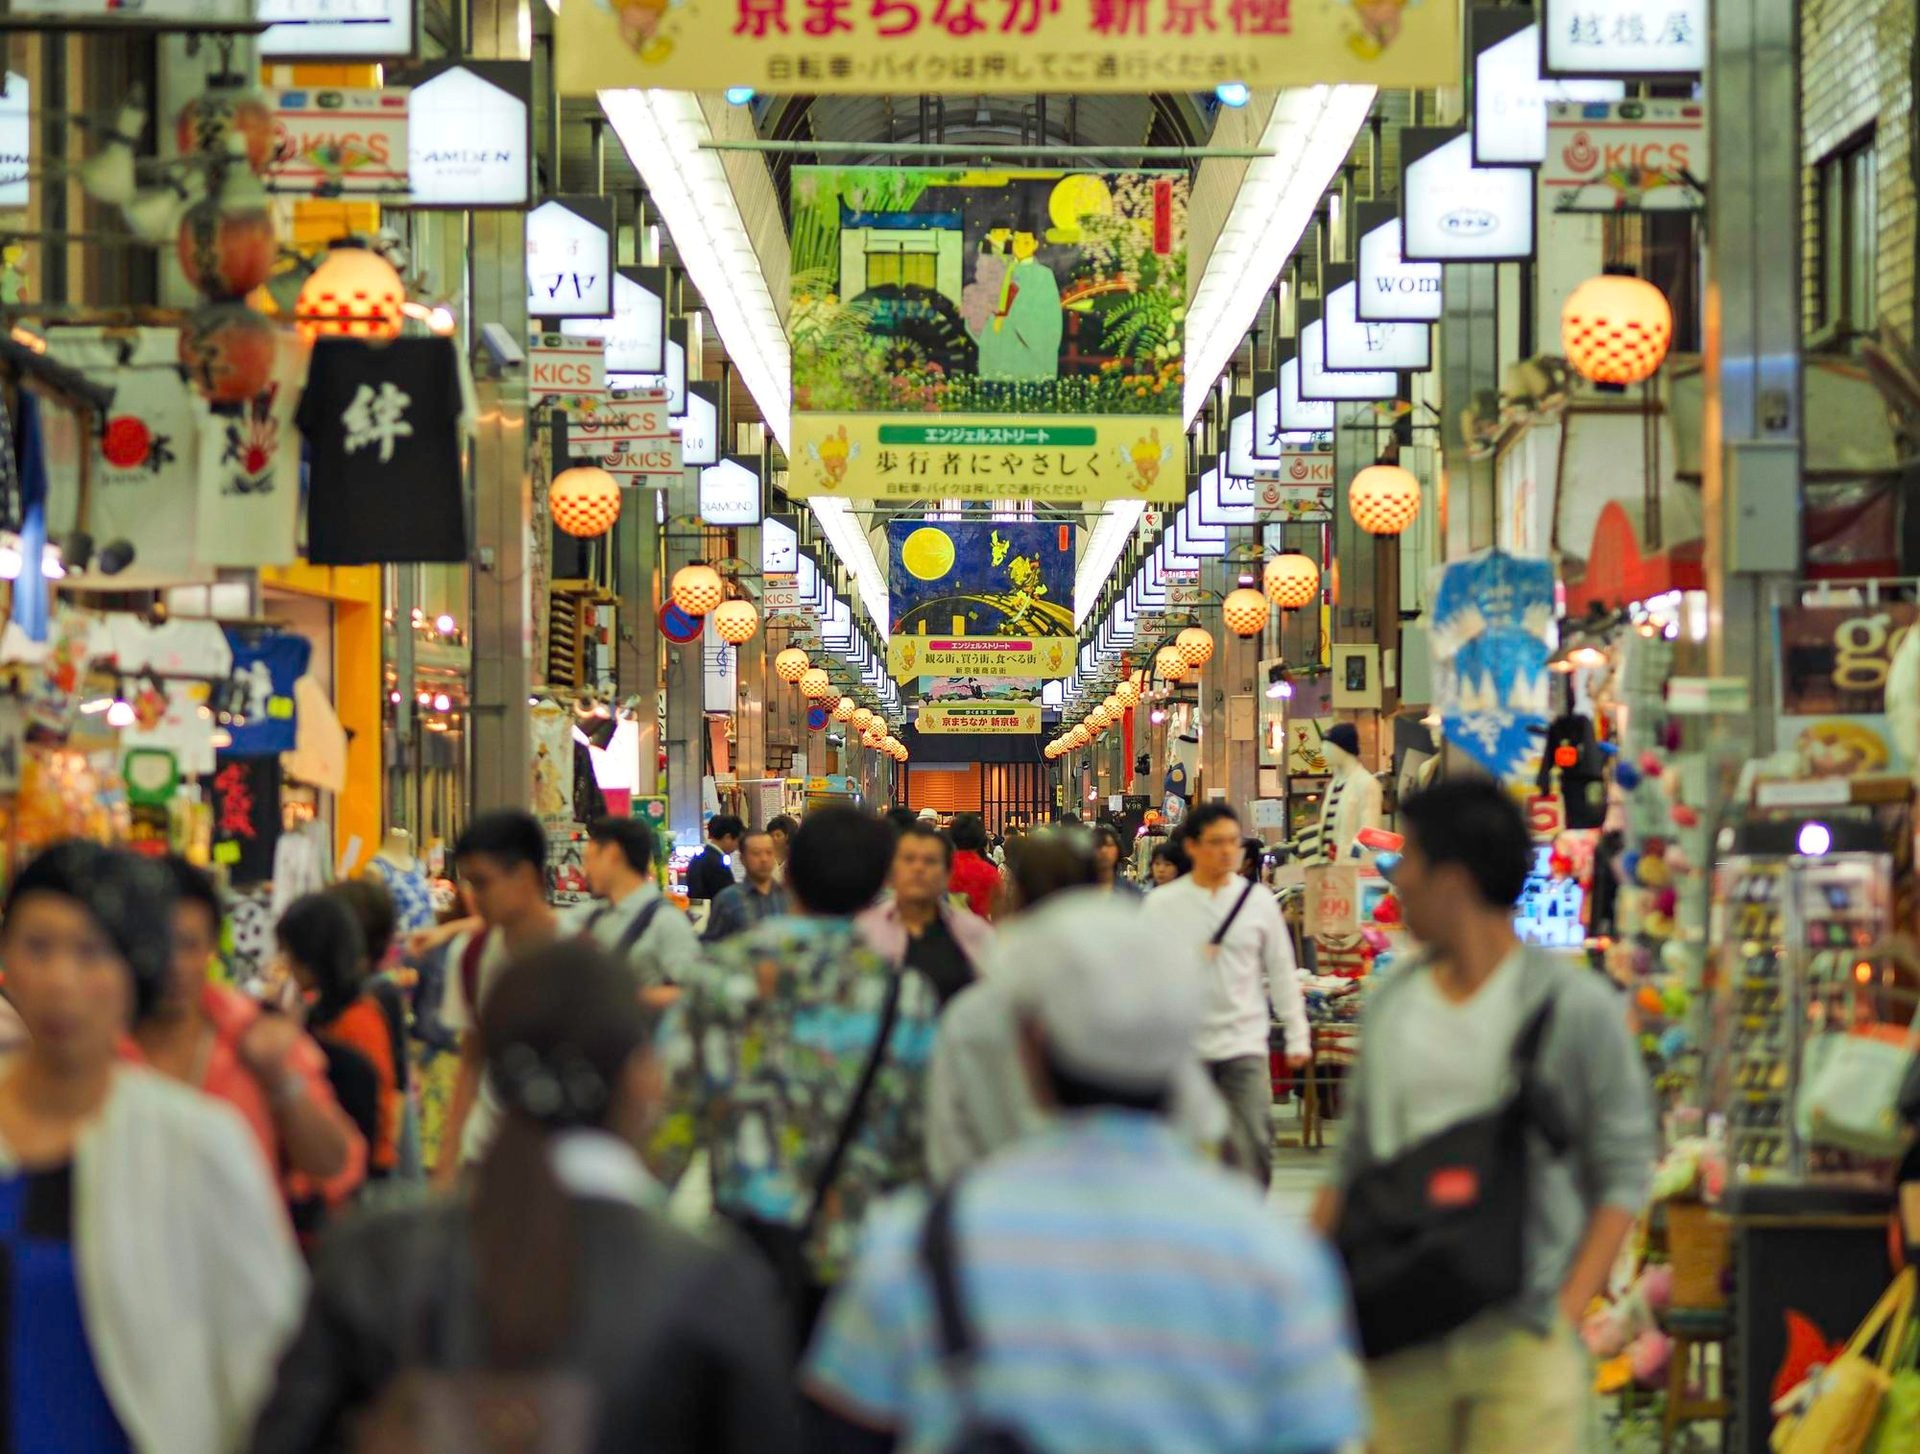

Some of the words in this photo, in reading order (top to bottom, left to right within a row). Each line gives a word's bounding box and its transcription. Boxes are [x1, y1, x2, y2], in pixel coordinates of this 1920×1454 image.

[1604, 143, 1690, 174] KICS
[533, 364, 592, 386] KICS
[341, 381, 414, 463] 絆
[603, 412, 657, 433] KICS
[924, 427, 1050, 444] エンジェルストリート
[625, 451, 673, 468] KICS
[876, 450, 1101, 477] 歩行者にやさしく
[886, 482, 1088, 496] 自転車・バイクは押してご通行ください
[700, 501, 752, 513] DIAMOND
[765, 593, 793, 605] KICS
[951, 642, 1011, 650] エンジェルストリート
[925, 653, 1037, 664] 観る街、買う街、食べる街
[955, 667, 1007, 675] 新京極商店街
[942, 717, 988, 727] 京まちなか
[991, 717, 1020, 727] 新京極
